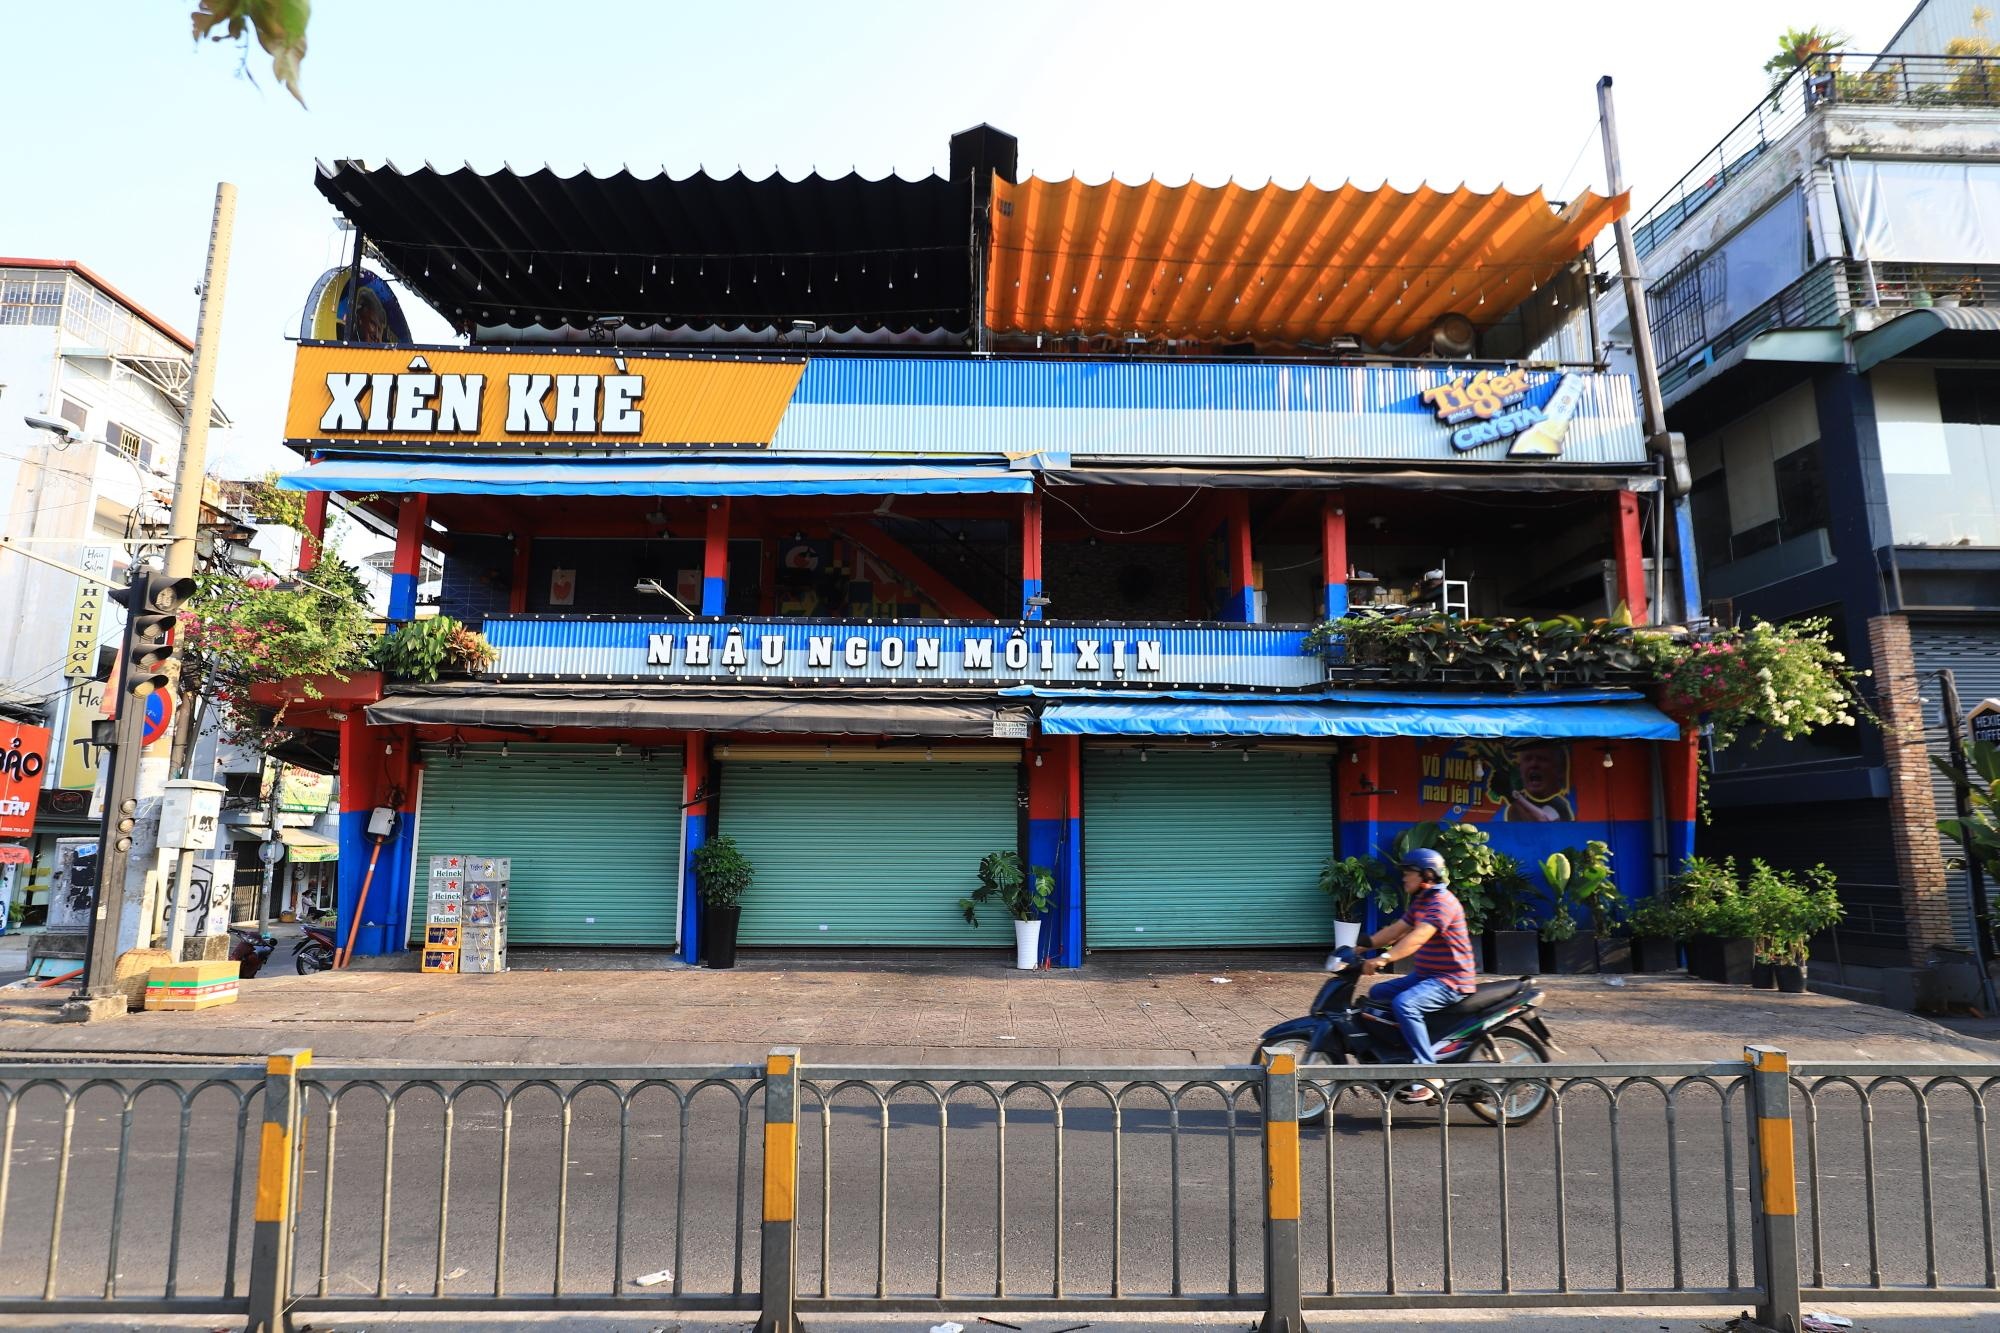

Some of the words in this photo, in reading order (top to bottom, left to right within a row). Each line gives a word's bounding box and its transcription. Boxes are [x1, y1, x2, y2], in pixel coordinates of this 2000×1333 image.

[320, 355, 486, 435] XIÊN
[505, 357, 644, 436] KHÈ
[1423, 368, 1531, 420] Tiger
[1453, 405, 1549, 451] CRYSTAL
[647, 626, 785, 674] NHẬU
[808, 636, 940, 670] NGON
[1076, 639, 1162, 680] XỊN
[78, 686, 102, 708] Ha
[1423, 785, 1448, 803] mau
[1451, 784, 1469, 805] lên
